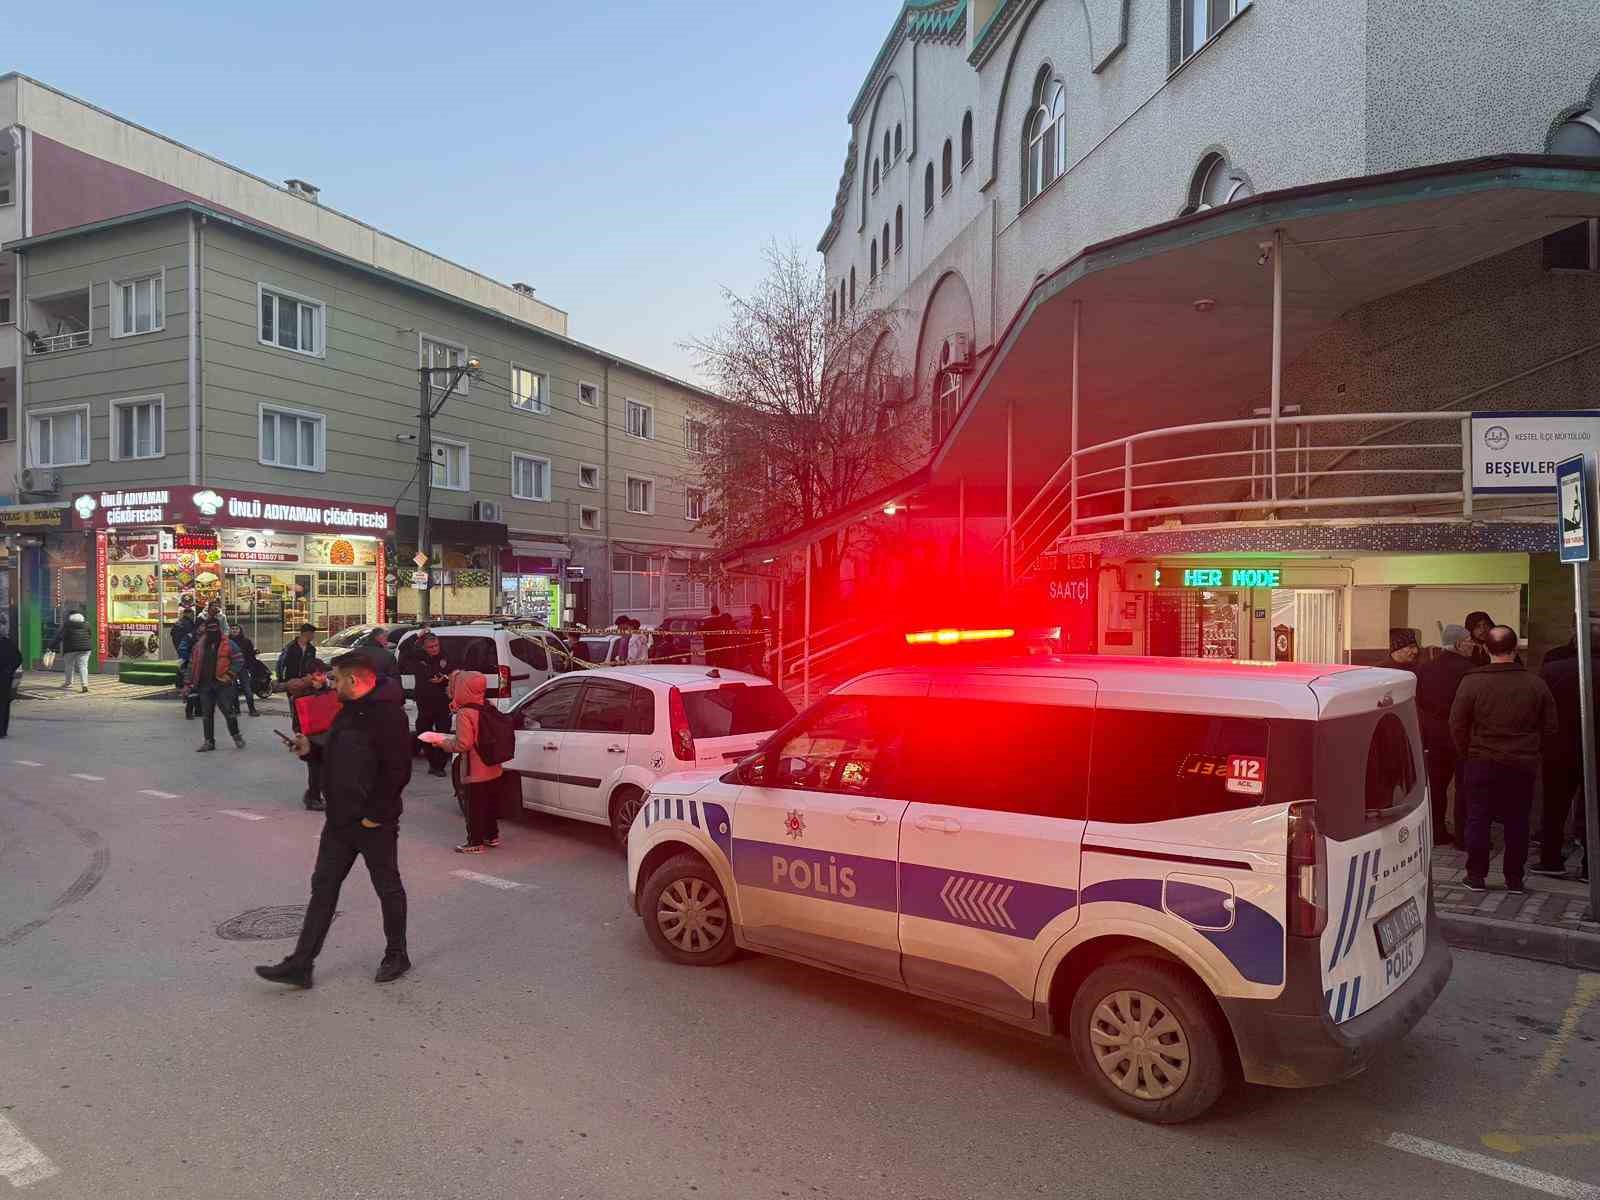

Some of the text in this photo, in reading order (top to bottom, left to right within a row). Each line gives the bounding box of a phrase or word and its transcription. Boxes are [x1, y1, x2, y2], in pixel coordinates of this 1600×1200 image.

[1486, 461, 1555, 477] BEŞEVLER
[124, 490, 168, 506] ADIYAMAN
[228, 497, 388, 529] ÜNLÜ ADIYAMAN ÇİĞKÖFTECİSİ
[1184, 569, 1280, 587] HER MODE
[1049, 577, 1089, 605] SAATÇİ
[1232, 760, 1260, 778] 112
[772, 855, 857, 898] POLİS
